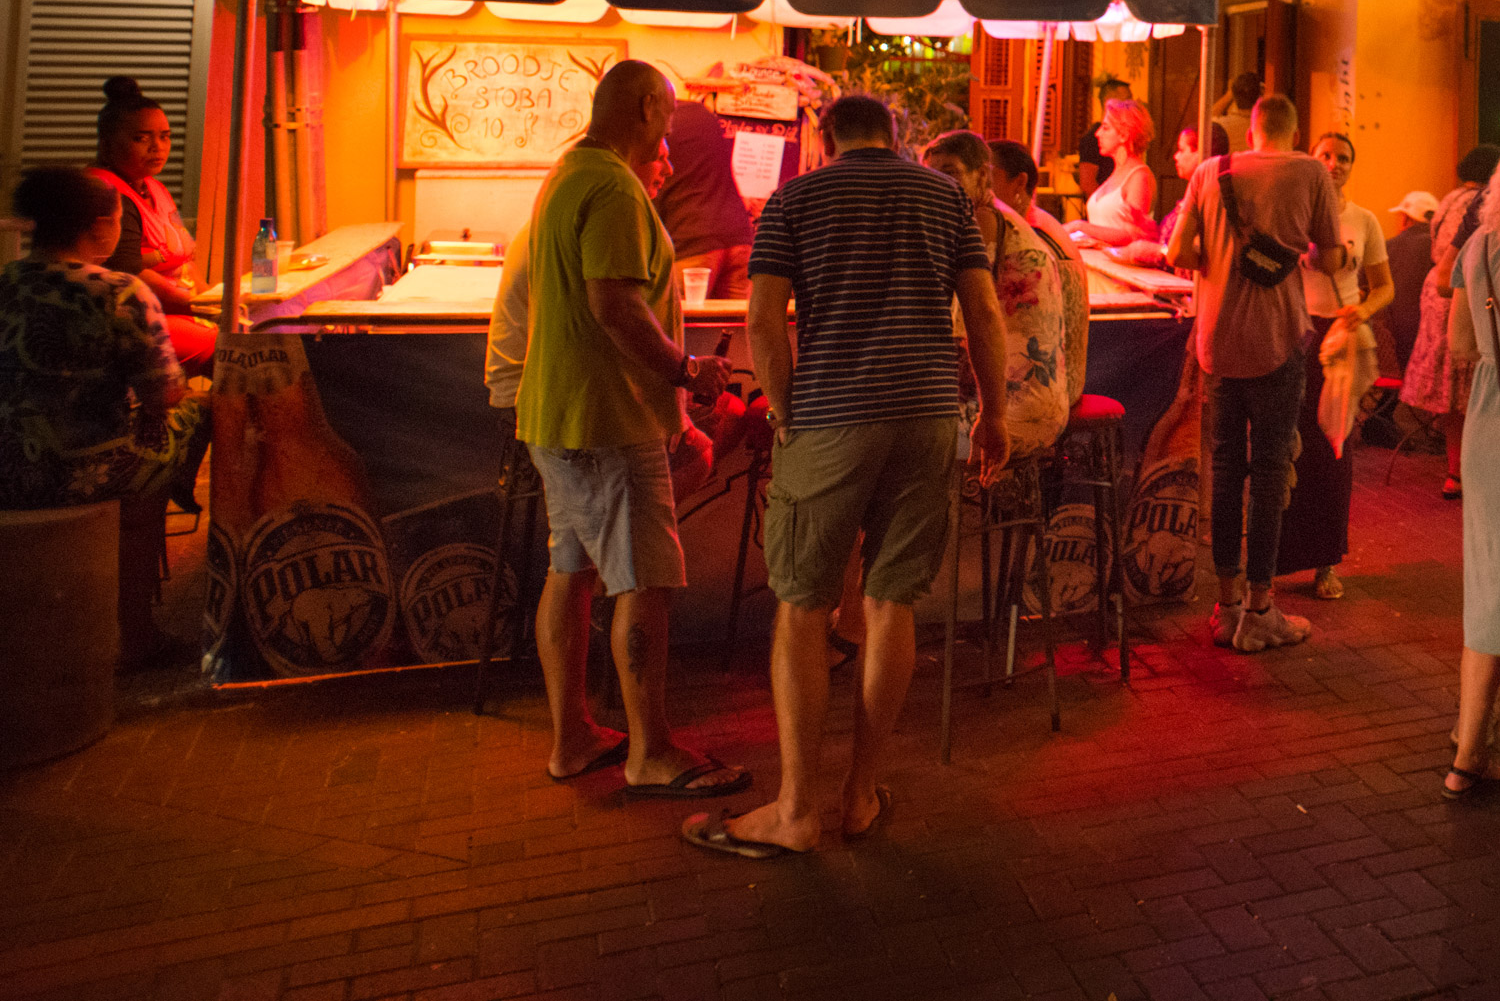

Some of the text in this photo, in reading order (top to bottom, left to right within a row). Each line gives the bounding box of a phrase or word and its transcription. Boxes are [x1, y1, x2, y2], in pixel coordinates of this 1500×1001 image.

[440, 53, 579, 99] BROODJE
[472, 86, 552, 112] STOBA
[481, 116, 504, 139] 10
[1124, 500, 1197, 545] POLA
[252, 550, 384, 620] POLAR
